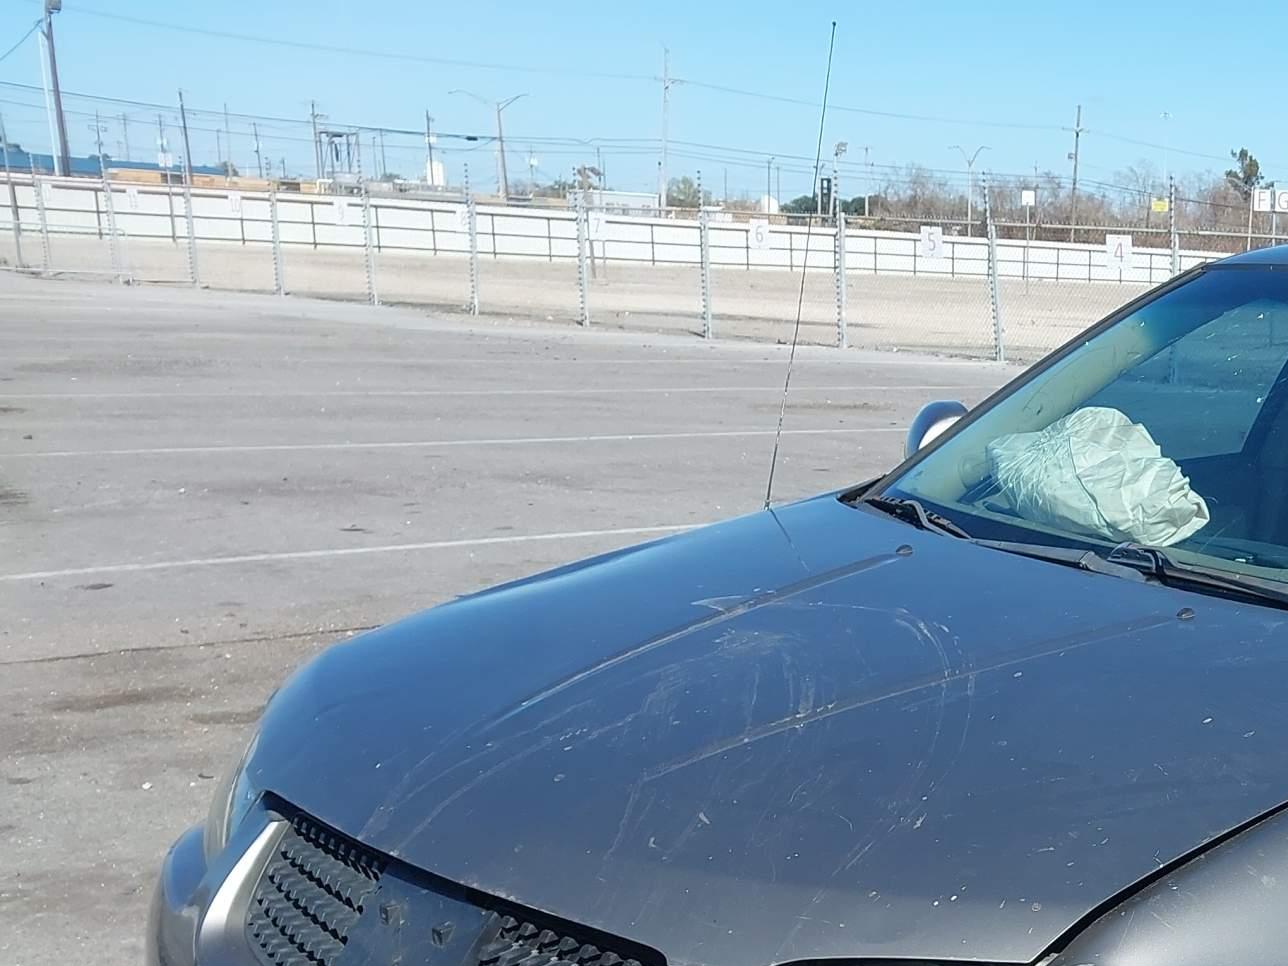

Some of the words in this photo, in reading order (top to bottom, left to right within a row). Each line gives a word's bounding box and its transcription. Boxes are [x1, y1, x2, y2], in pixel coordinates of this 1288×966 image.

[1258, 191, 1267, 210] F
[592, 217, 601, 234] 7
[754, 225, 764, 243] 6
[927, 232, 937, 251] 5
[1114, 242, 1124, 262] 4
